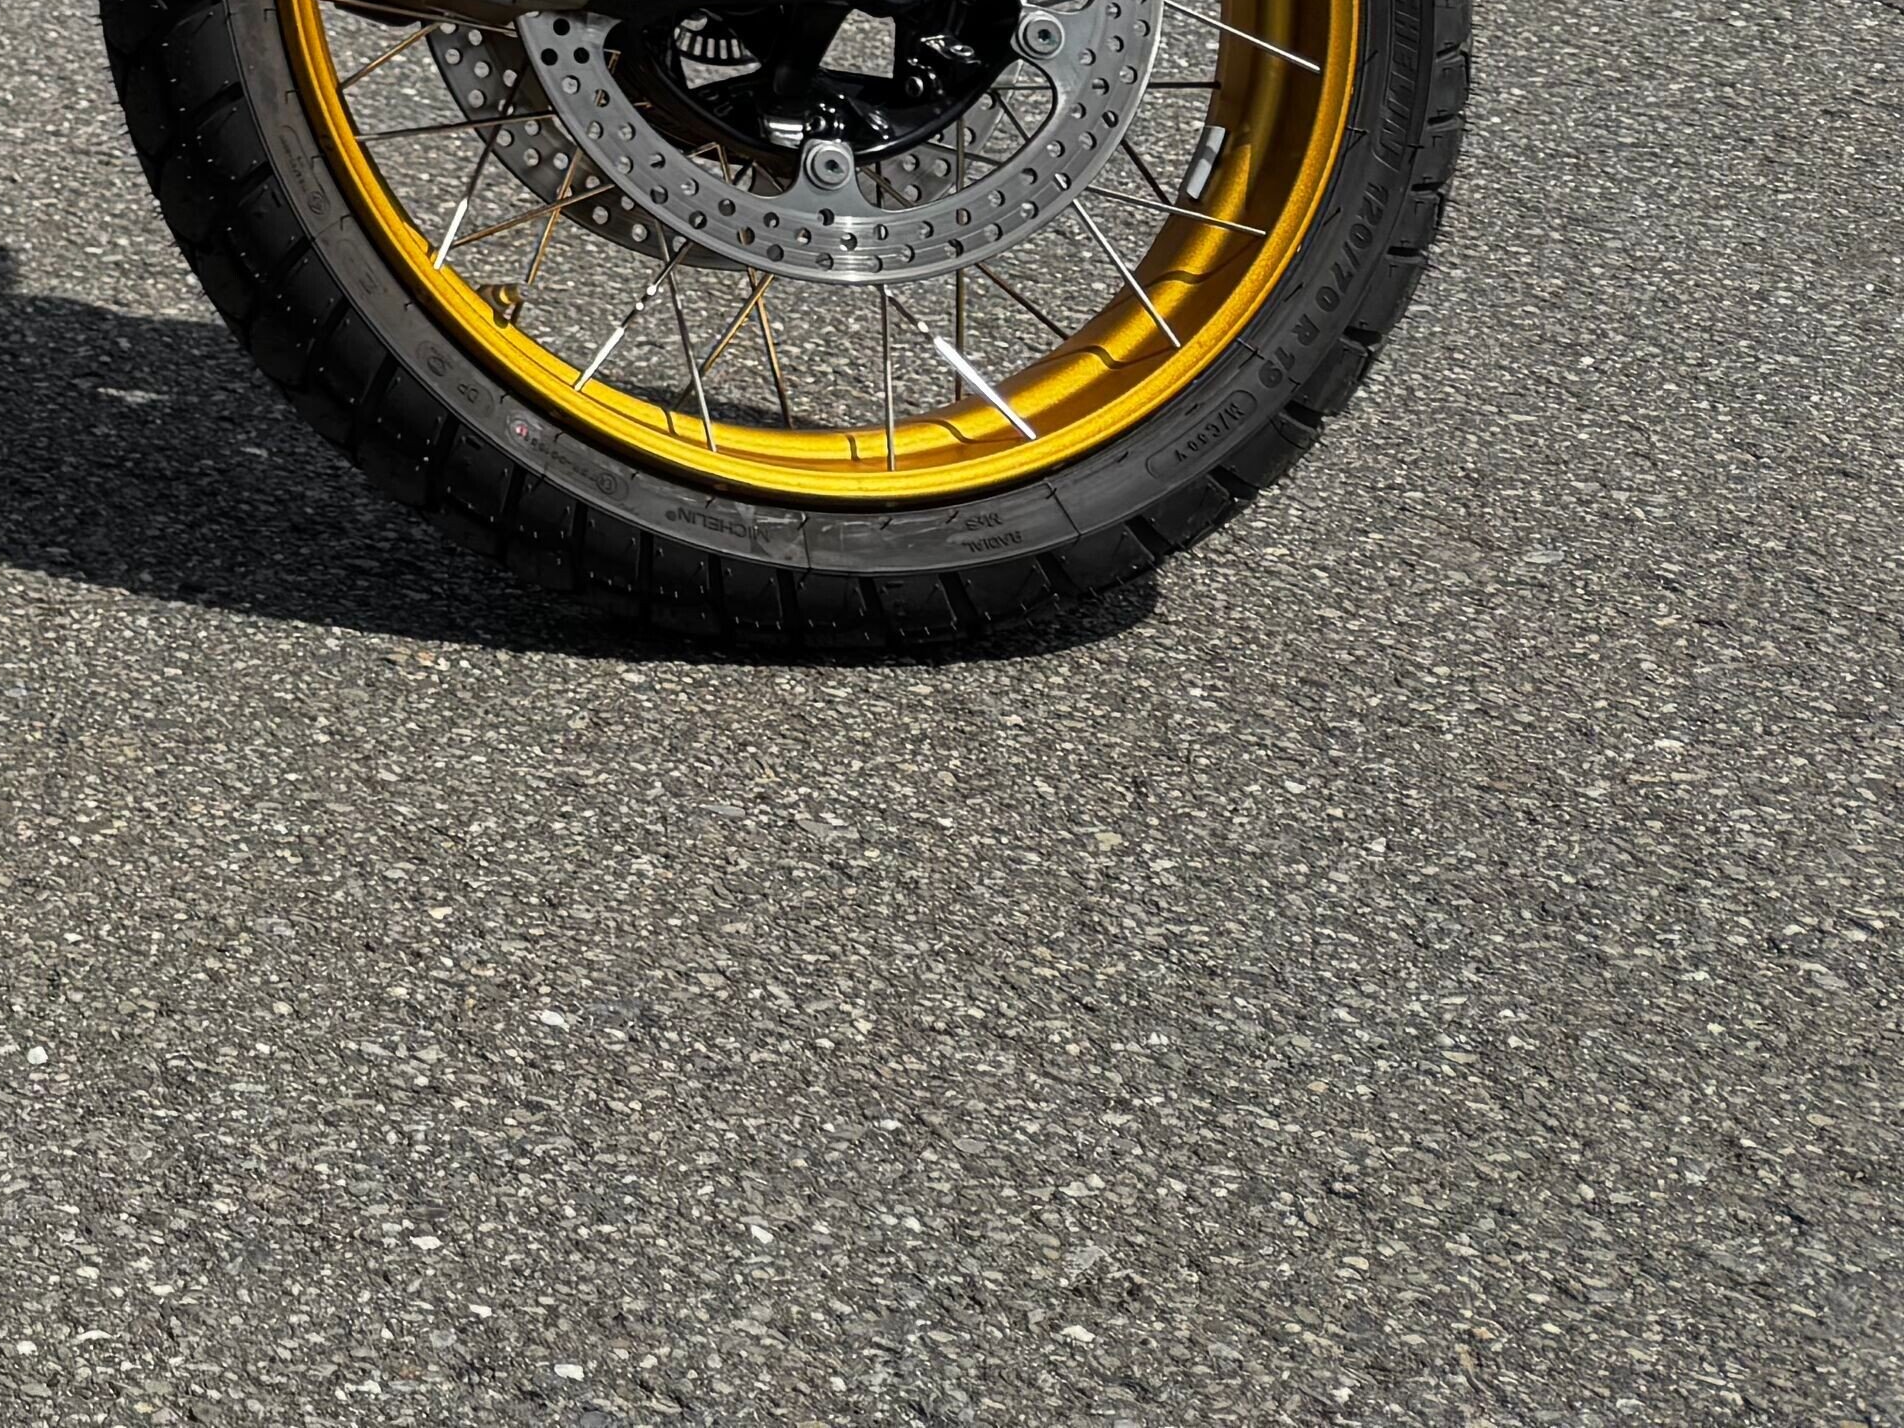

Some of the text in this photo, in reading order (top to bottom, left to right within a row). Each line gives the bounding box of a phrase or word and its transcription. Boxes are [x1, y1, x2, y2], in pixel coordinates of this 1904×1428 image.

[1251, 179, 1393, 393] 120/70 R 19
[959, 528, 1024, 553] RADIAL
